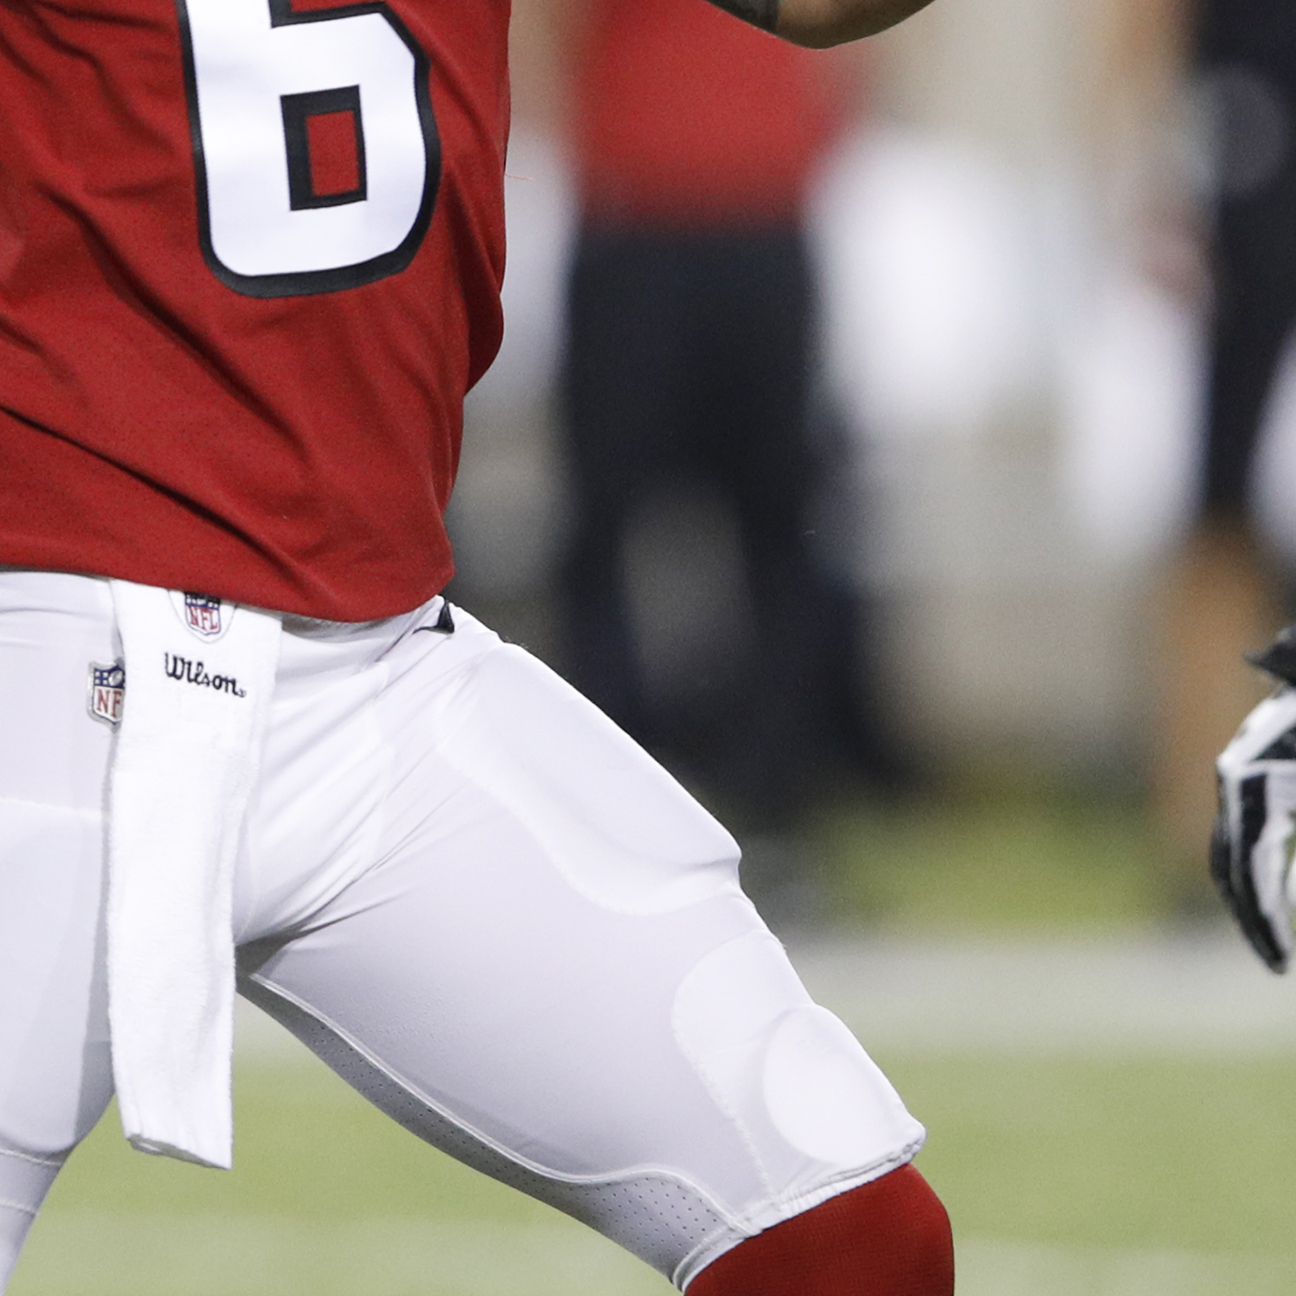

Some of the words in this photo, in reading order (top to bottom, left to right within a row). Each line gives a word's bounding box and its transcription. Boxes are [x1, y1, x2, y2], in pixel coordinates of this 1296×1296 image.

[189, 605, 219, 631] NFL
[164, 652, 242, 697] Wilson
[96, 688, 125, 718] NF
